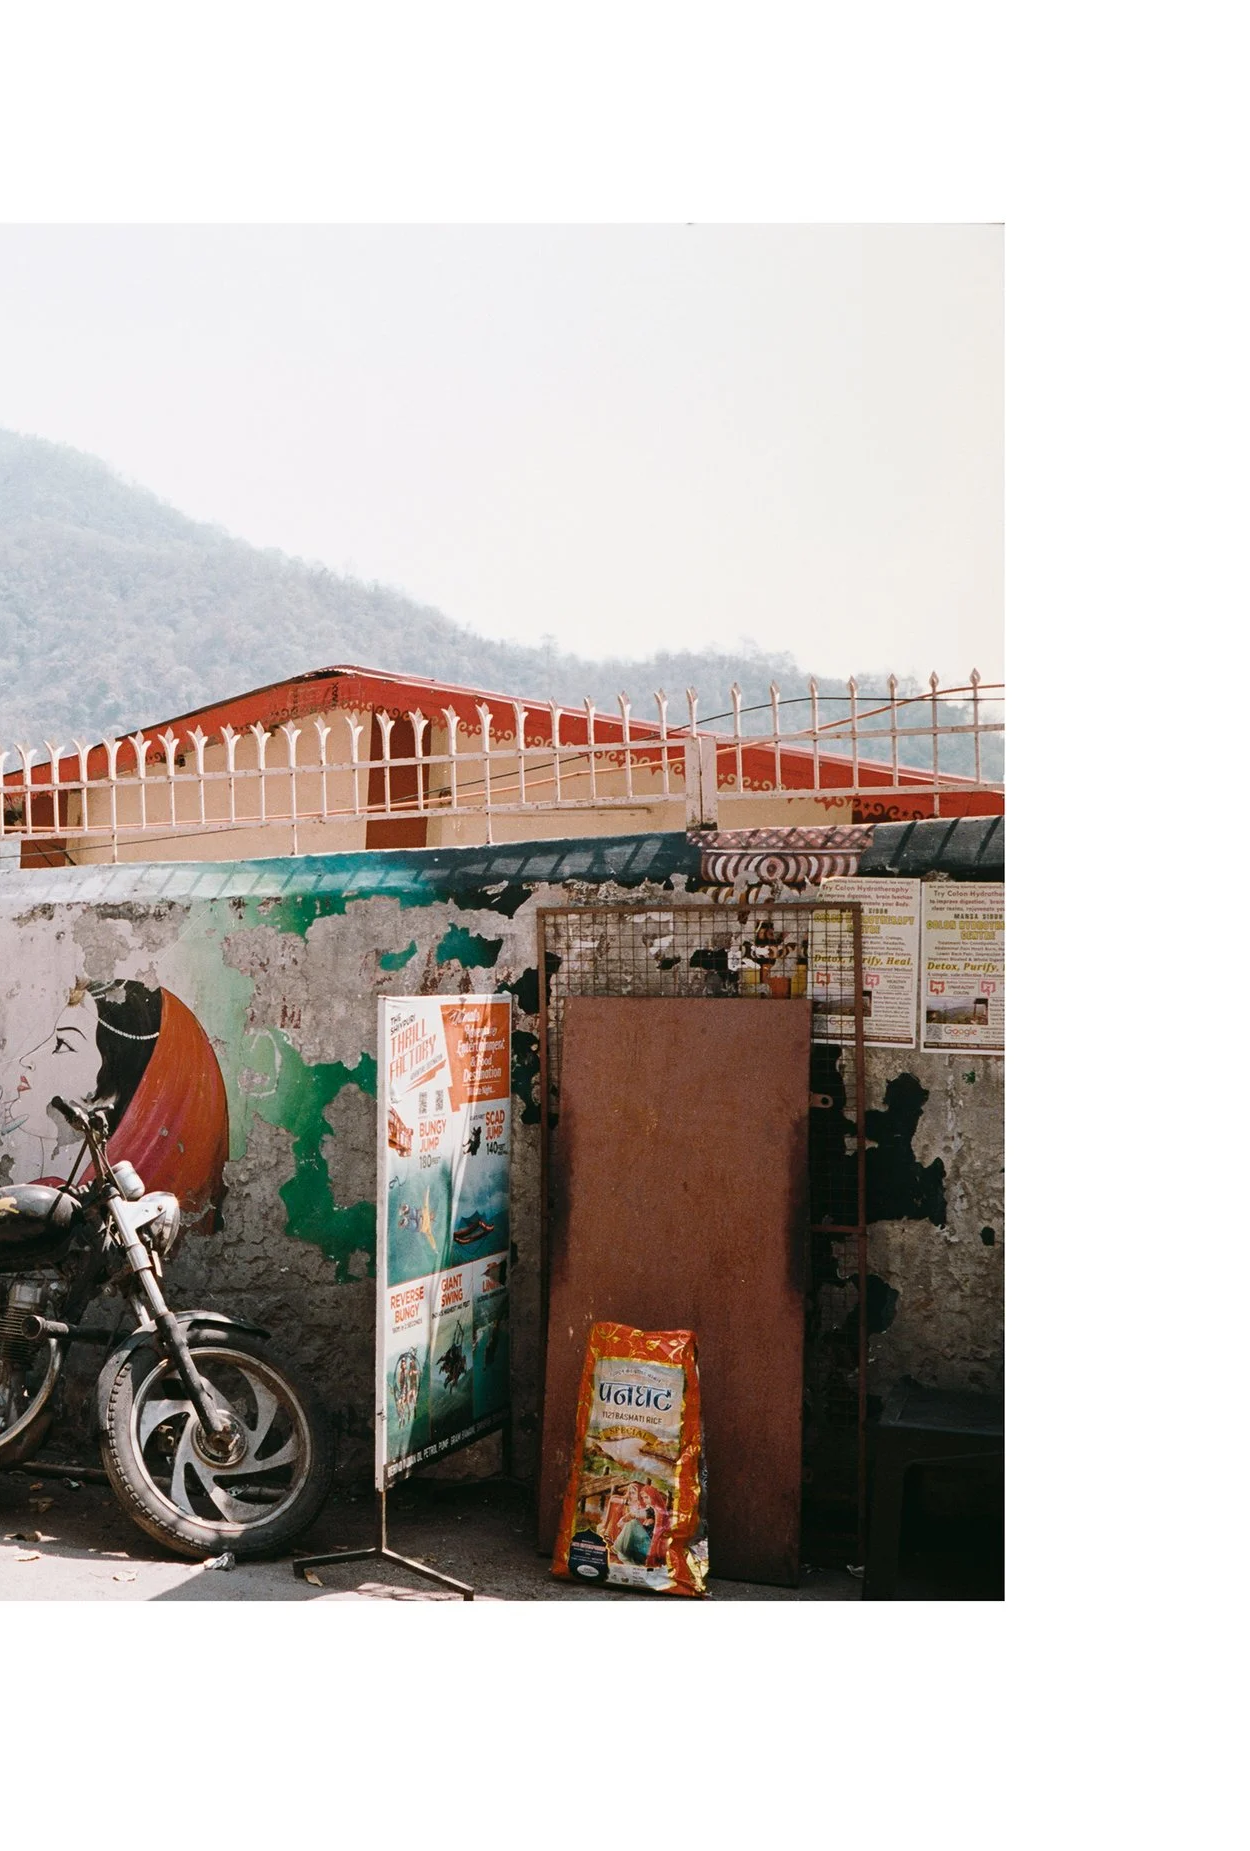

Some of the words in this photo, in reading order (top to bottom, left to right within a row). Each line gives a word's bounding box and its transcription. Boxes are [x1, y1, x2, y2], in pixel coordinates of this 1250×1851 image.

[926, 920, 956, 930] COLON
[961, 931, 995, 940] CENTRE
[814, 954, 846, 963] Detox,
[849, 956, 883, 965] Prify,
[886, 957, 914, 965] Heal.
[927, 962, 960, 971] Detox,
[830, 1016, 855, 1028] Goog
[390, 1018, 427, 1059] THRILL
[944, 1026, 977, 1037] Google
[390, 1034, 436, 1080] FACTORY
[464, 1067, 501, 1082] Destination
[486, 1110, 505, 1126] SCAD
[419, 1118, 446, 1137] BUNGY
[485, 1125, 503, 1140] JUMP
[419, 1137, 439, 1152] JUMP
[486, 1141, 497, 1155] 140
[441, 1273, 462, 1292] GIANT
[390, 1286, 424, 1309] REVERSE
[441, 1289, 463, 1308] SWING
[394, 1303, 419, 1324] BUNGY
[616, 1412, 645, 1422] BASMATI
[646, 1416, 662, 1424] RICE
[610, 1426, 647, 1439] SPECIAL
